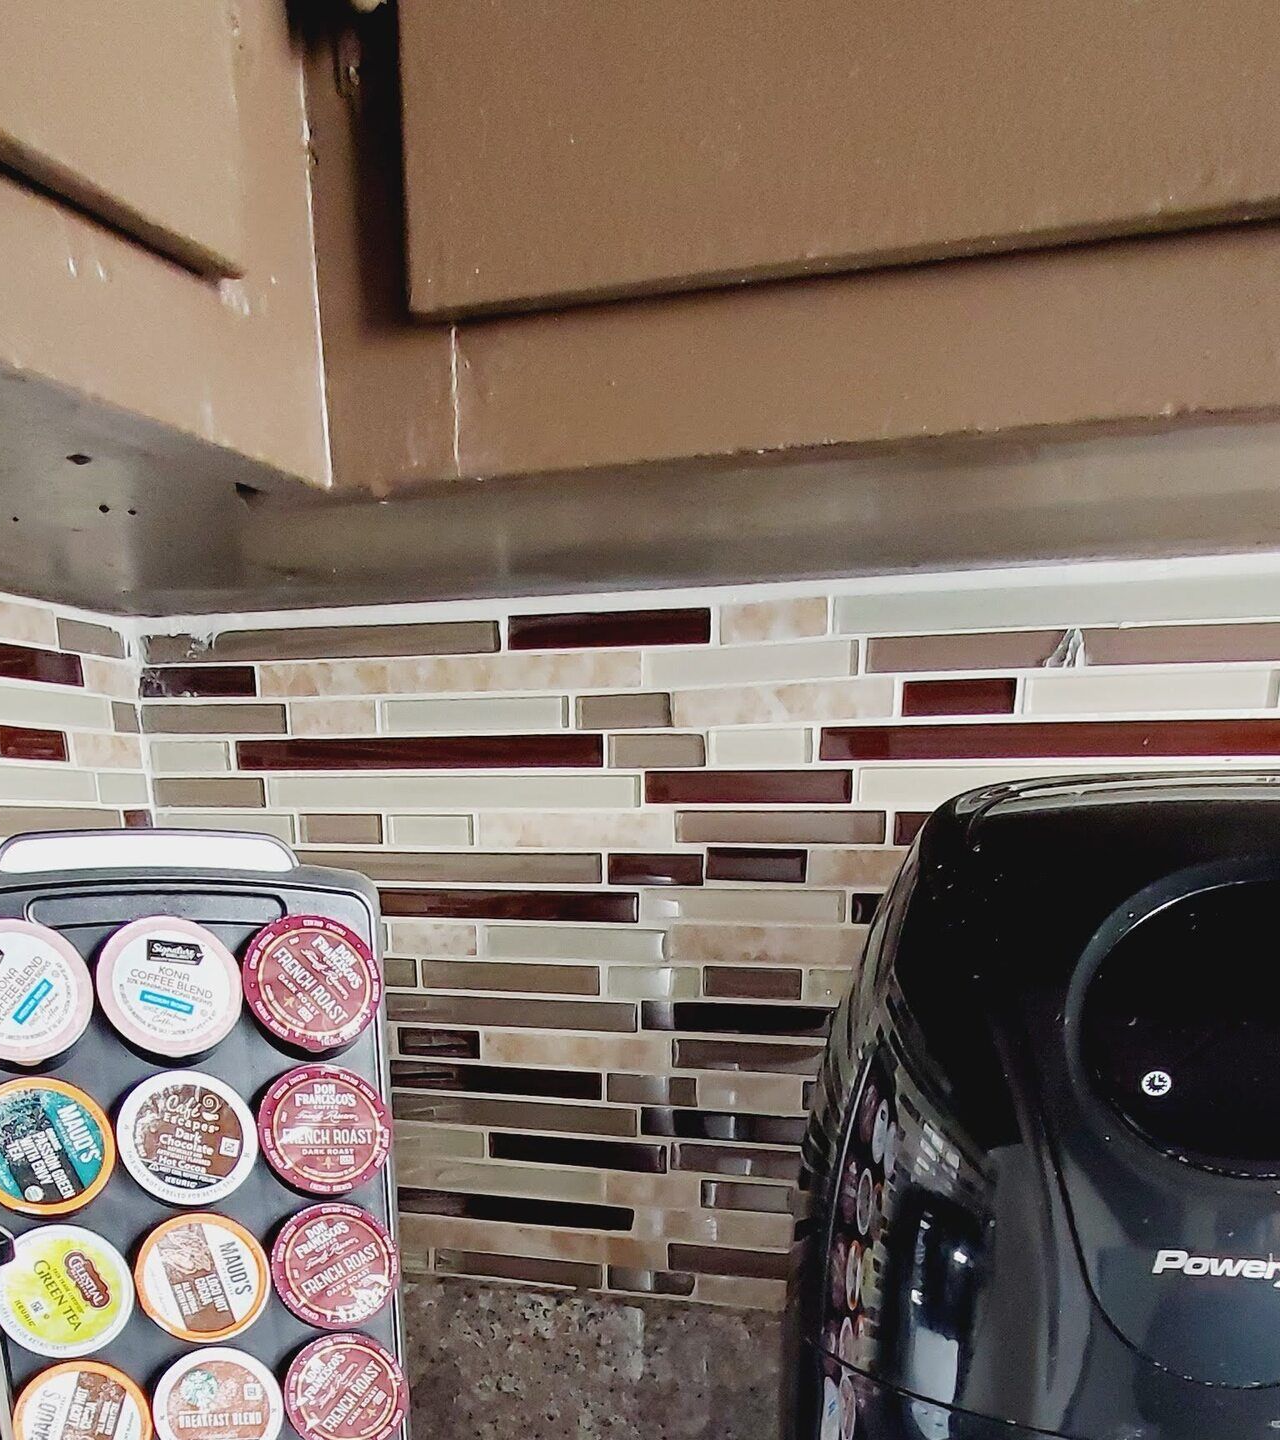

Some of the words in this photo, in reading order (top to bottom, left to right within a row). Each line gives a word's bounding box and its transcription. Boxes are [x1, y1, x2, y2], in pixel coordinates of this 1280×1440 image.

[334, 944, 358, 967] DON
[16, 955, 43, 987] BLEND
[130, 968, 174, 988] COFFEE
[176, 982, 213, 999] BLEND
[159, 966, 190, 982] KONA
[273, 947, 318, 990] FRENCH
[310, 985, 349, 1025] ROAST
[278, 974, 298, 993] DARK
[297, 991, 320, 1015] ROAST
[294, 1093, 357, 1107] FRANCISCO'S
[313, 1083, 336, 1094] DON
[166, 1095, 202, 1119] Café
[57, 1103, 102, 1163] MAUD'S
[163, 1111, 216, 1133] Escapes
[175, 1128, 202, 1143] Dark
[6, 1140, 25, 1161] TEA
[160, 1134, 214, 1155] Chocolate
[282, 1128, 330, 1145] FRENCH
[333, 1129, 372, 1144] ROAST
[21, 1136, 41, 1162] WITH
[31, 1159, 54, 1184] ENVY
[32, 1131, 61, 1171] PASSION
[52, 1168, 76, 1199] GREEN
[159, 1155, 177, 1166] Hot
[178, 1160, 207, 1174] Cocoa
[164, 1176, 197, 1188] KEURIG
[294, 1222, 350, 1259] FRANCISCO'S
[305, 1221, 328, 1240] DON
[68, 1254, 104, 1305] CELESTIAL
[219, 1241, 252, 1295] MAUD'S
[301, 1263, 343, 1297] FRENCH
[343, 1242, 379, 1272] ROAST
[34, 1260, 68, 1306] GREEN
[63, 1305, 82, 1332] TEA
[194, 1276, 213, 1306] COCOA
[205, 1274, 222, 1296] LOCO
[326, 1282, 347, 1297] DARK
[348, 1268, 371, 1284] ROAST
[15, 1299, 36, 1327] KEURIG
[212, 1294, 229, 1312] HOT
[321, 1391, 358, 1433] FRENCH
[350, 1360, 382, 1396] ROAST
[346, 1407, 363, 1426] DARK
[361, 1386, 379, 1408] ROAST
[178, 1412, 229, 1428] BREAKFAST
[232, 1411, 262, 1425] BLEND
